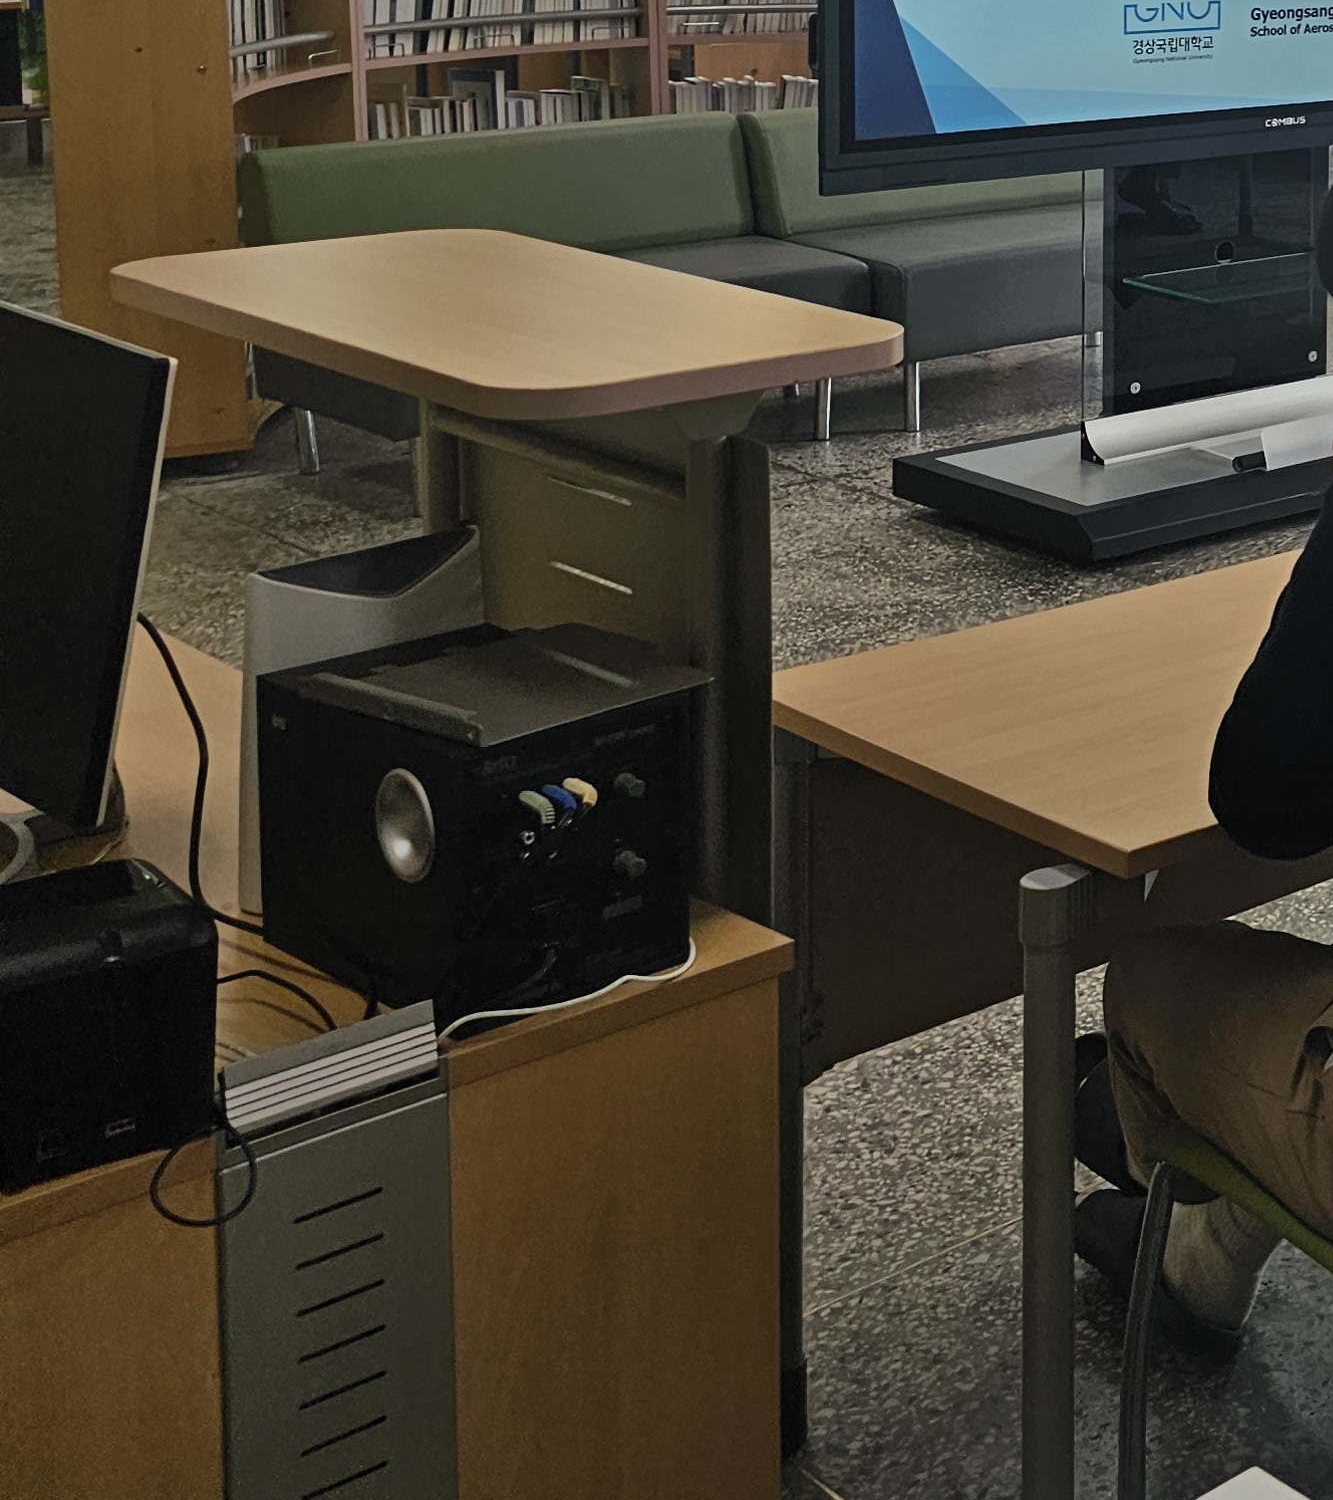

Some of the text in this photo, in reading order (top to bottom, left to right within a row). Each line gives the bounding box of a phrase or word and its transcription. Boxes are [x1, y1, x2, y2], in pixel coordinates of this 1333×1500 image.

[1250, 25, 1287, 37] School
[1290, 24, 1301, 35] of
[1133, 36, 1214, 55] 경상국립대학교
